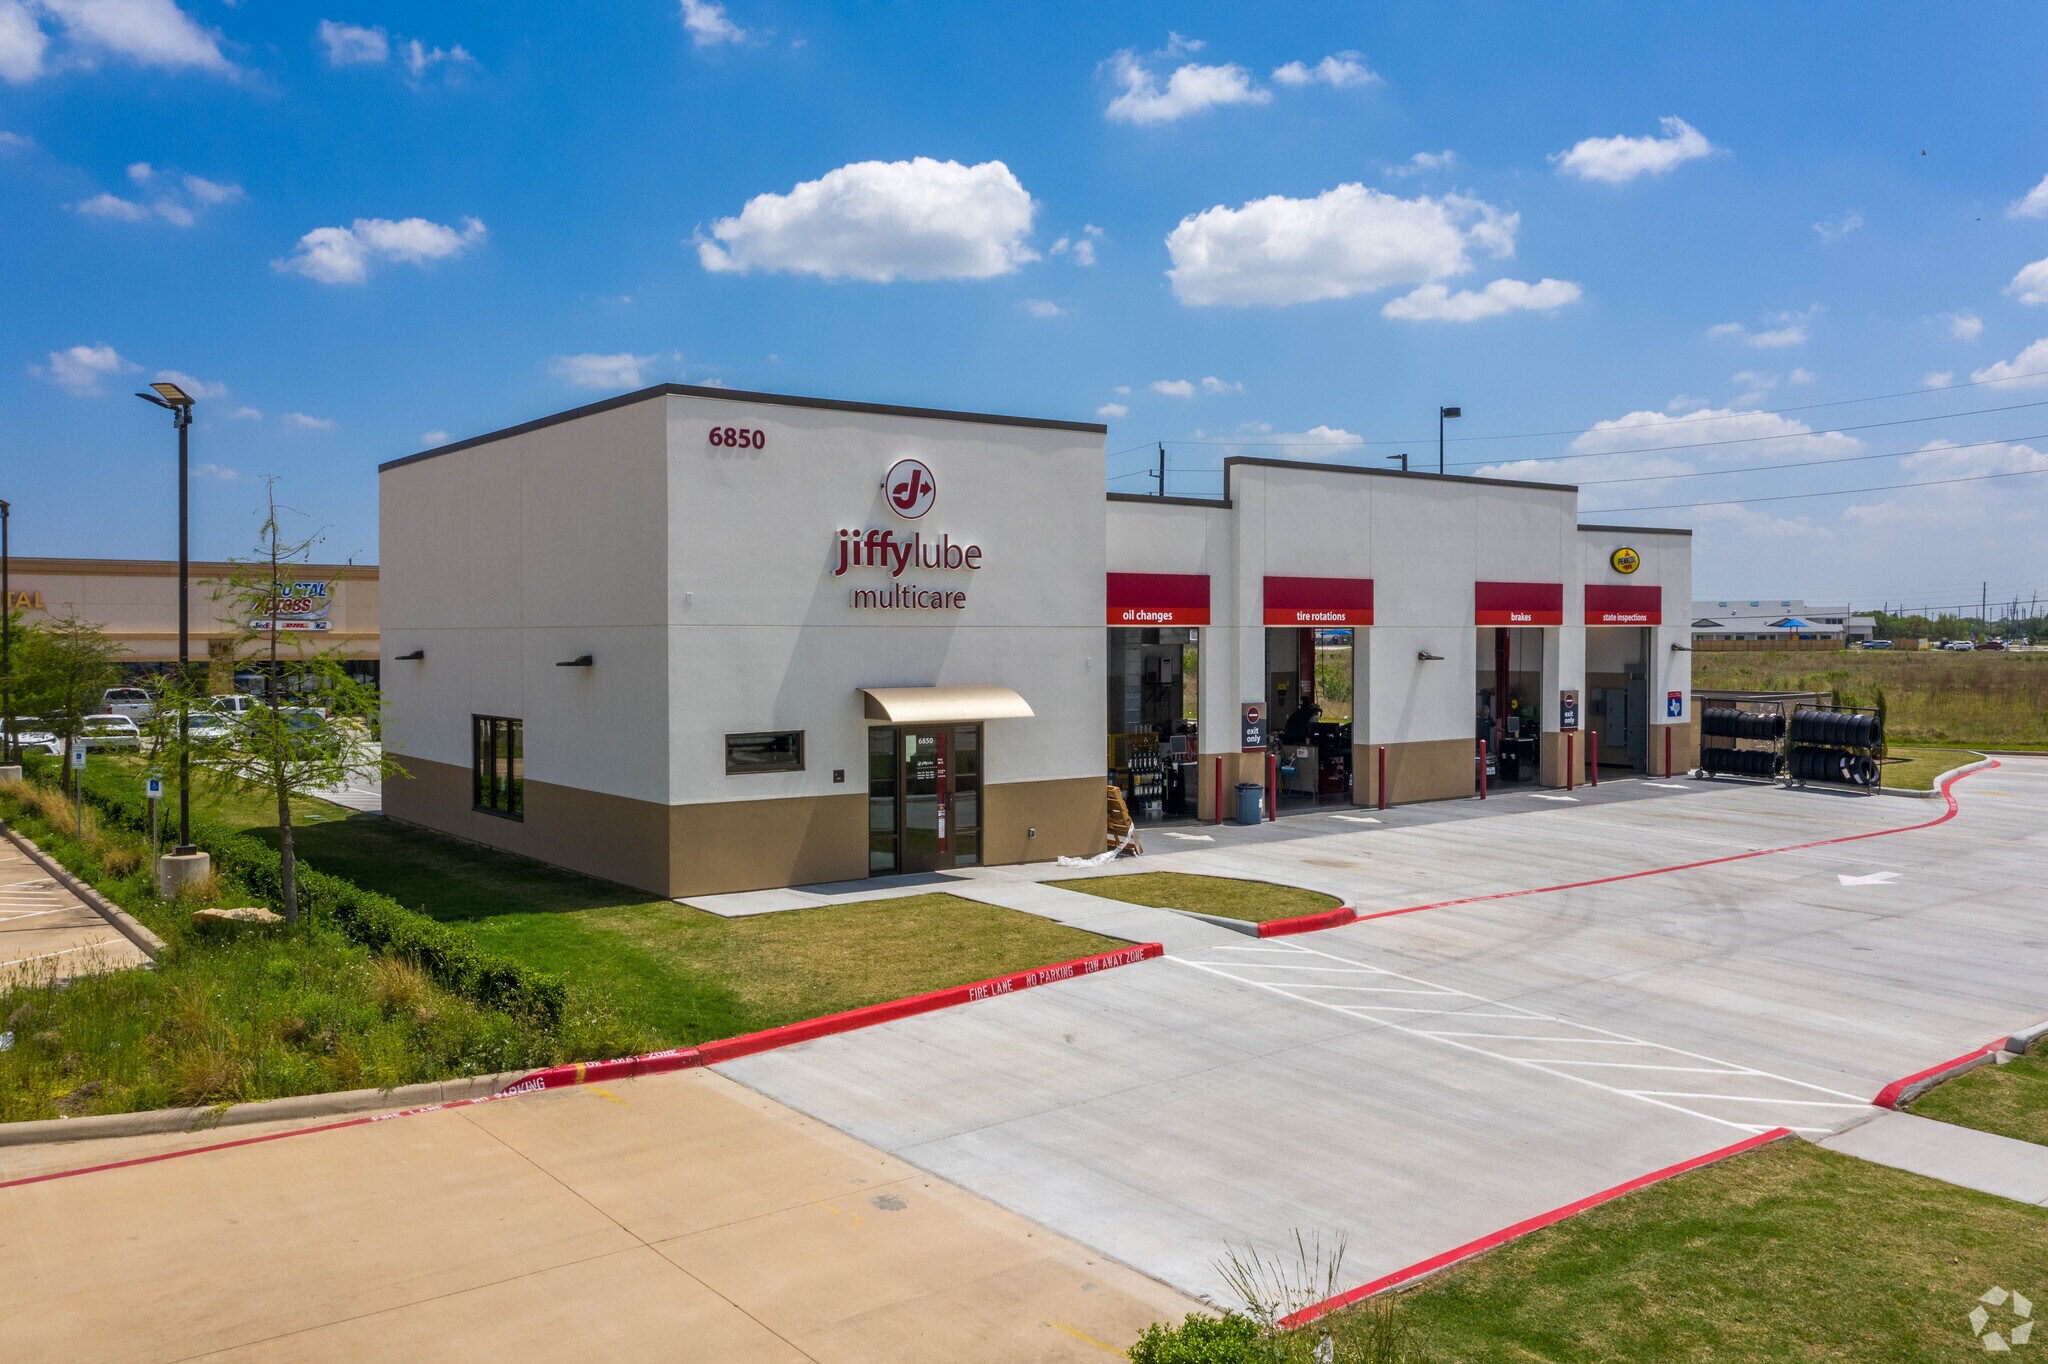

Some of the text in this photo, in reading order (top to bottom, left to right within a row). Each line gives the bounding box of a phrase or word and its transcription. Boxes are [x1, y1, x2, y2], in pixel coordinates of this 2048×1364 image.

[709, 426, 766, 450] 6850
[854, 582, 967, 609] multicare
[1122, 610, 1173, 623] oil changes
[1296, 611, 1346, 621] tire rotations
[1510, 612, 1532, 622] brakes
[1602, 613, 1647, 623] state inspections
[1564, 717, 1575, 725] only
[1246, 726, 1259, 735] exit
[918, 737, 934, 745] 6850
[1246, 735, 1261, 744] only
[969, 949, 1145, 1001] FIRE LANE NO PARKING TOW AWAY ZONE
